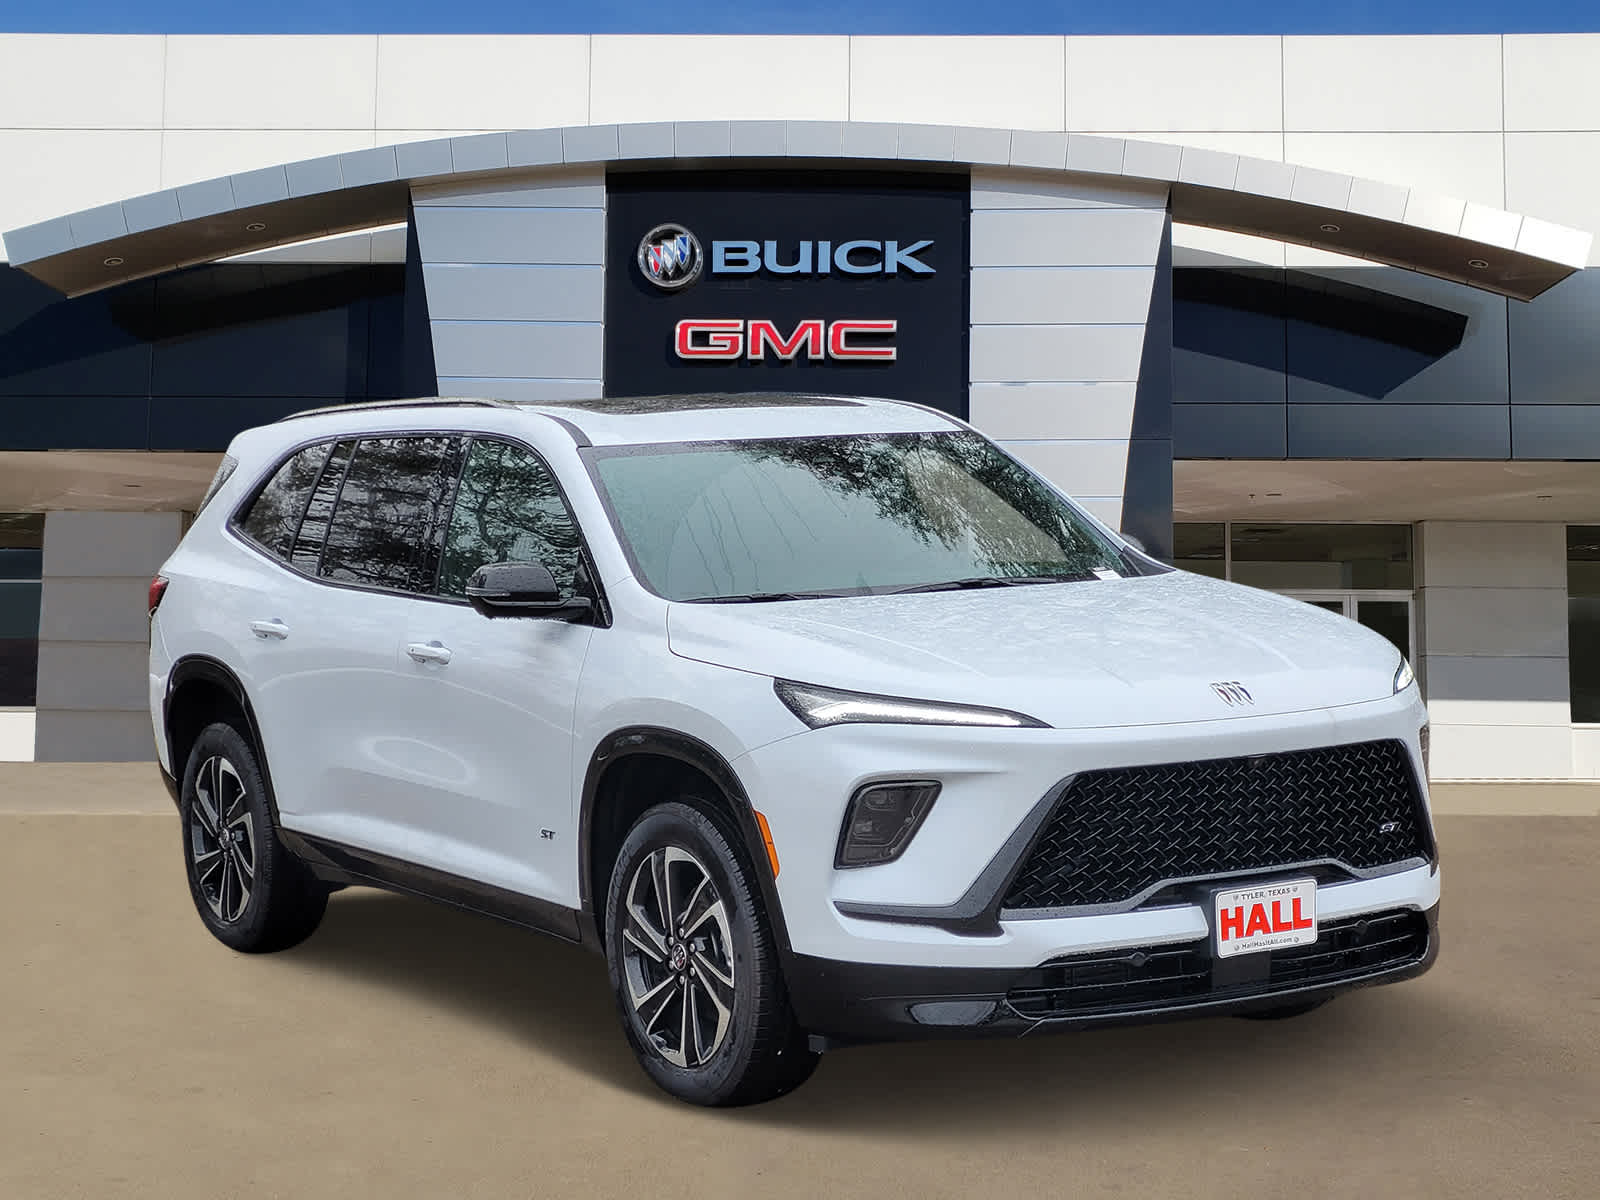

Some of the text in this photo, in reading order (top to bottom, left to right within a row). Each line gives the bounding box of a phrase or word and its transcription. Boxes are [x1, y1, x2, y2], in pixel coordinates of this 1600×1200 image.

[712, 240, 936, 273] BUICK
[675, 319, 897, 360] GMC
[541, 829, 556, 840] ST
[1379, 822, 1400, 834] ST
[1268, 887, 1291, 897] TEXAS
[1220, 897, 1313, 942] HALL
